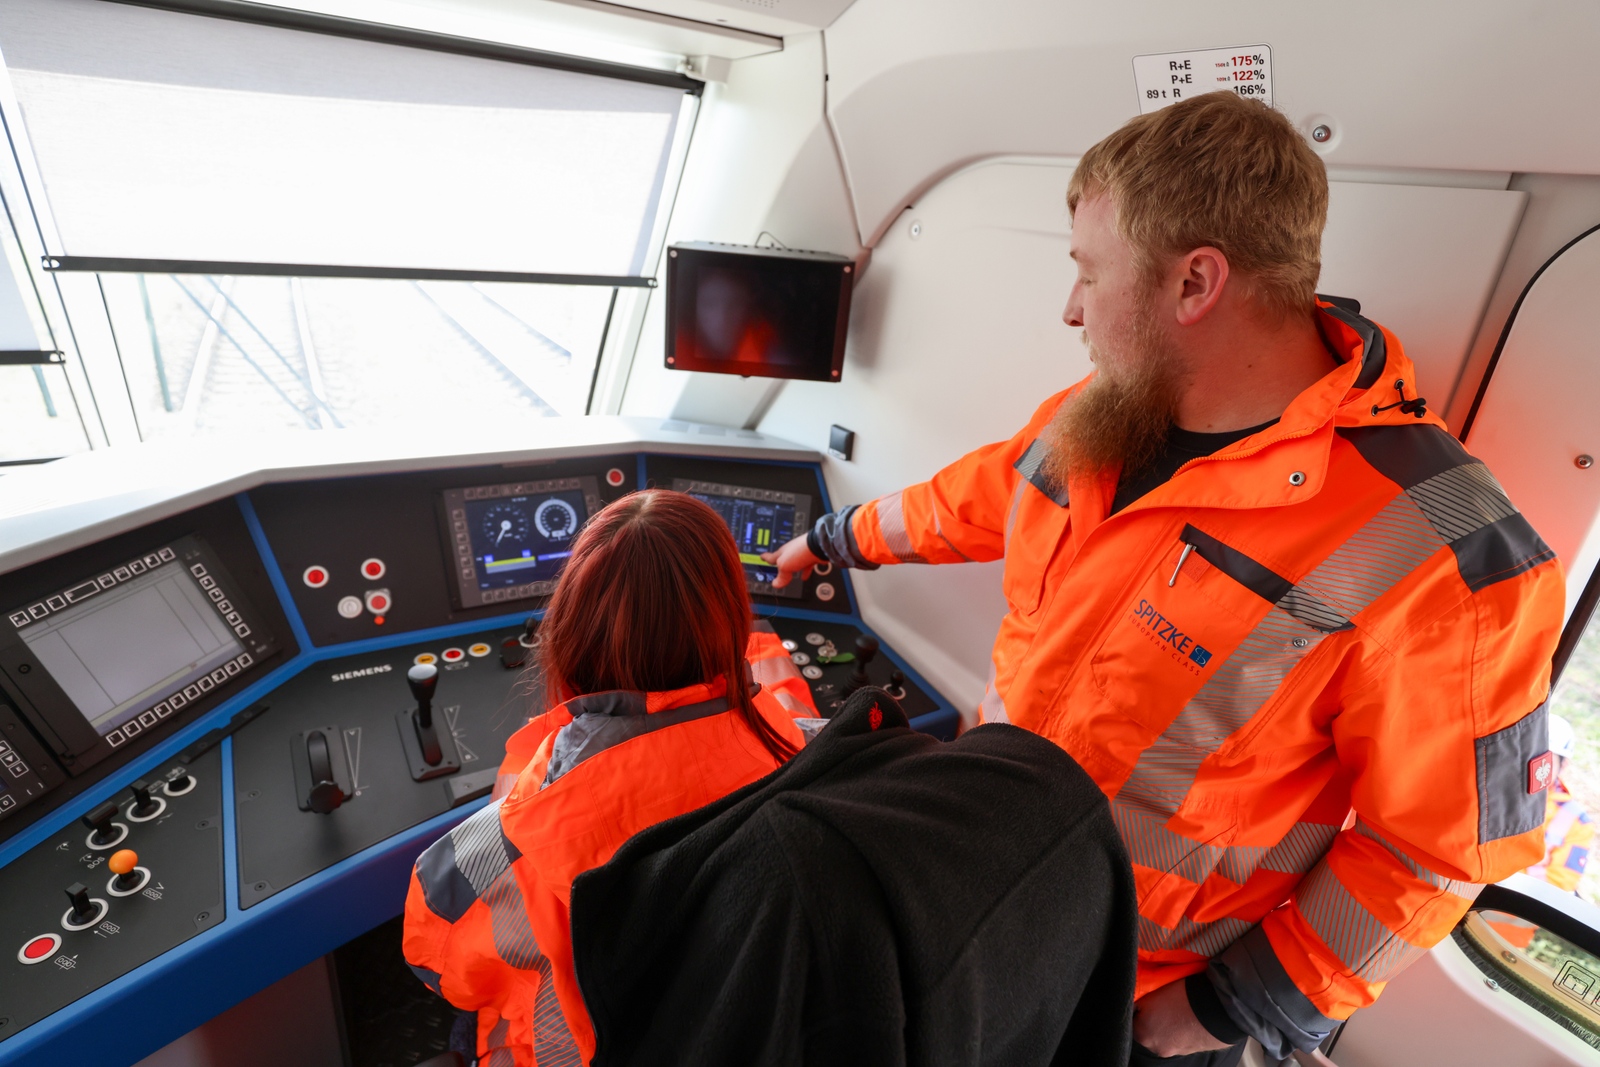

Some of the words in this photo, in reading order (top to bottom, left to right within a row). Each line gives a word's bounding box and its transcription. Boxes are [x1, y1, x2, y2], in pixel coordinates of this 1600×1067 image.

[1169, 60, 1191, 71] R+E
[1231, 54, 1264, 66] 175%
[1171, 74, 1192, 84] P+E
[1232, 69, 1265, 81] 122%
[1146, 90, 1159, 98] 89
[1162, 90, 1166, 98] t
[1173, 88, 1181, 98] R
[1234, 84, 1266, 95] 166%
[1134, 599, 1193, 654] SPITZKE
[1128, 614, 1167, 652] EUROPEAN
[1172, 652, 1200, 676] CLASS
[331, 664, 392, 682] SIEMENS
[87, 857, 105, 869] SOS
